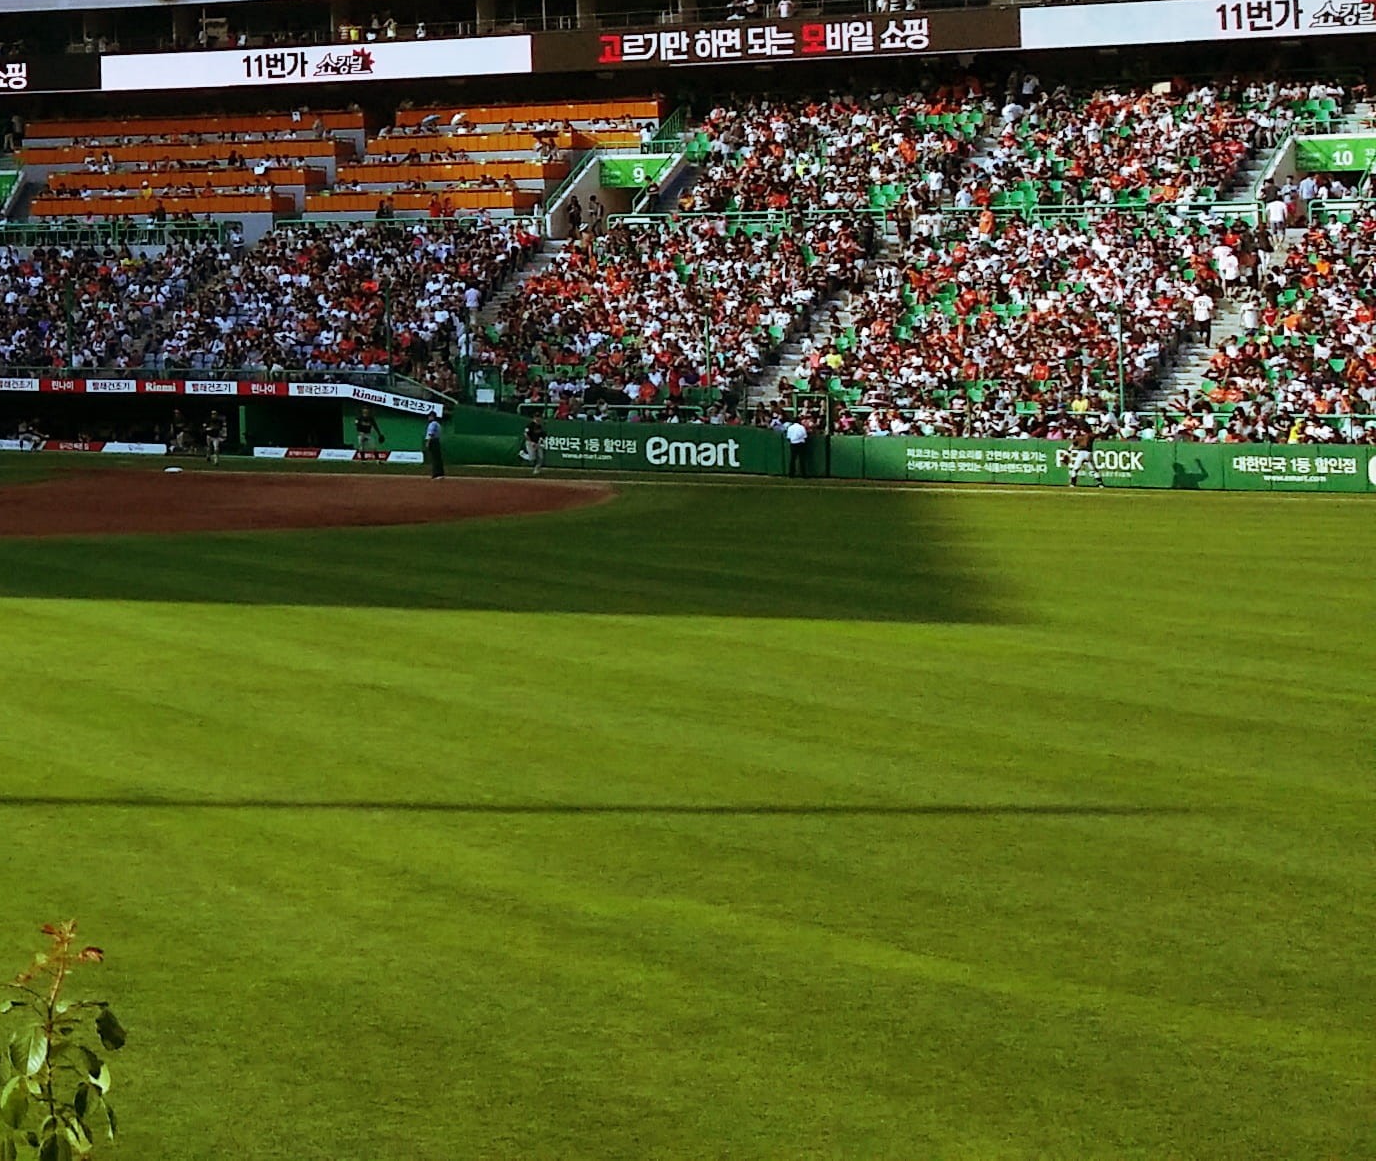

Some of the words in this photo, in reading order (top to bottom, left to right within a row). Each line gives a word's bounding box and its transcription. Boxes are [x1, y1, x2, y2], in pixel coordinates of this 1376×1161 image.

[1216, 0, 1303, 31] 11번가
[1309, 0, 1376, 28] 쇼킹딜
[599, 34, 689, 63] 고르기만
[695, 29, 741, 59] 하면
[747, 24, 795, 57] 되는
[802, 21, 874, 54] 모바일
[880, 18, 930, 51] 쇼핑
[242, 52, 308, 79] 11번가
[313, 52, 373, 77] 쇼킹딜
[1332, 149, 1354, 166] 10
[633, 168, 644, 183] 9
[51, 381, 74, 391] 린나이
[145, 382, 175, 392] Rinnai
[192, 382, 231, 393] 빨래건조기
[251, 382, 275, 394] 린나이
[297, 383, 338, 395] 빨래건조기
[352, 388, 385, 404] Rinnai
[393, 397, 435, 413] 빨래건조기
[584, 439, 599, 451] 1등
[604, 439, 636, 453] 할인점
[646, 437, 740, 468] emart
[1056, 449, 1144, 471] PECOCK
[1233, 456, 1287, 473] 대한민국
[1290, 458, 1311, 473] 1등
[1315, 457, 1357, 474] 할인점
